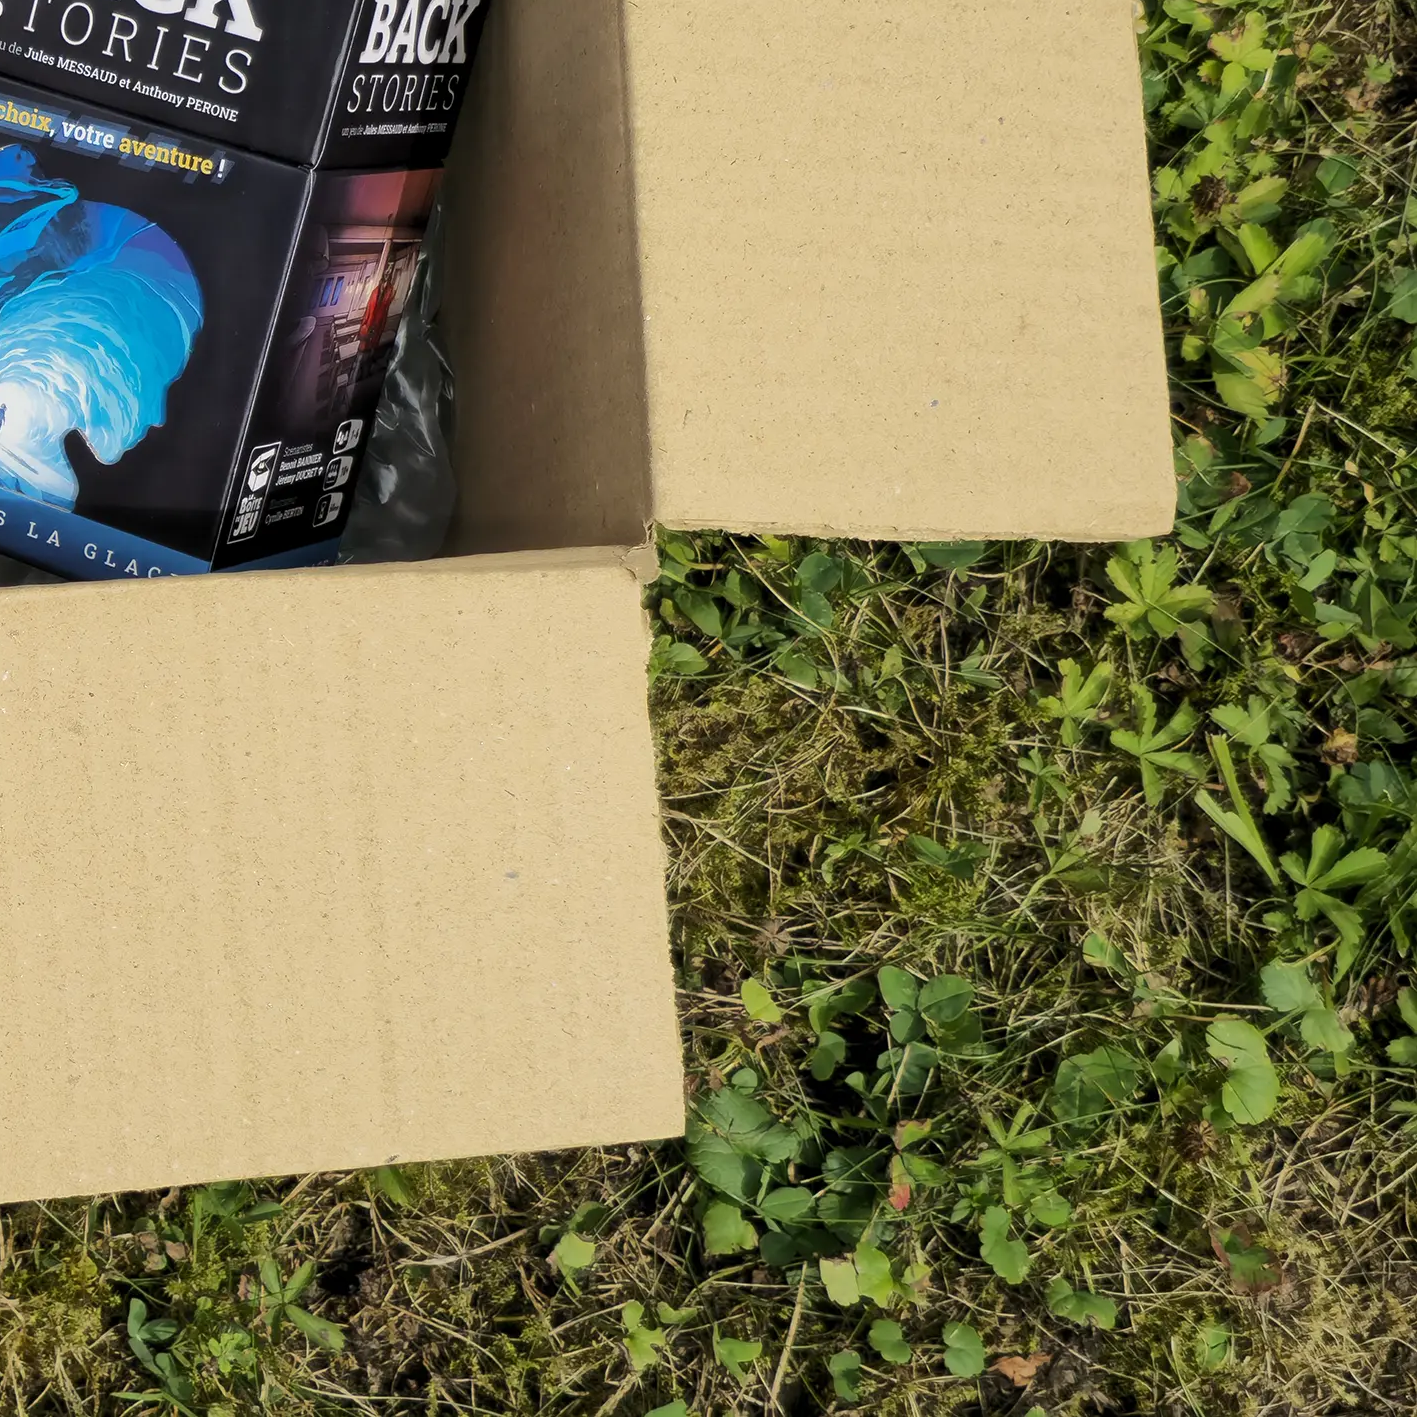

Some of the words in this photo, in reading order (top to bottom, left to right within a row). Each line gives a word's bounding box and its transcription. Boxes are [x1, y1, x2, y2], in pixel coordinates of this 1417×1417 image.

[8, 42, 23, 56] de
[24, 46, 55, 67] Jules
[57, 56, 118, 85] MESSAUD
[119, 77, 131, 89] et
[132, 80, 185, 108] Anthony
[185, 96, 239, 122] PERONE
[346, 73, 460, 113] STORIES
[61, 120, 115, 149] votre
[118, 135, 214, 176] aventure
[216, 158, 226, 179] !
[26, 521, 62, 549] LA
[83, 542, 179, 579] GLAC
[232, 510, 259, 537] JEU
